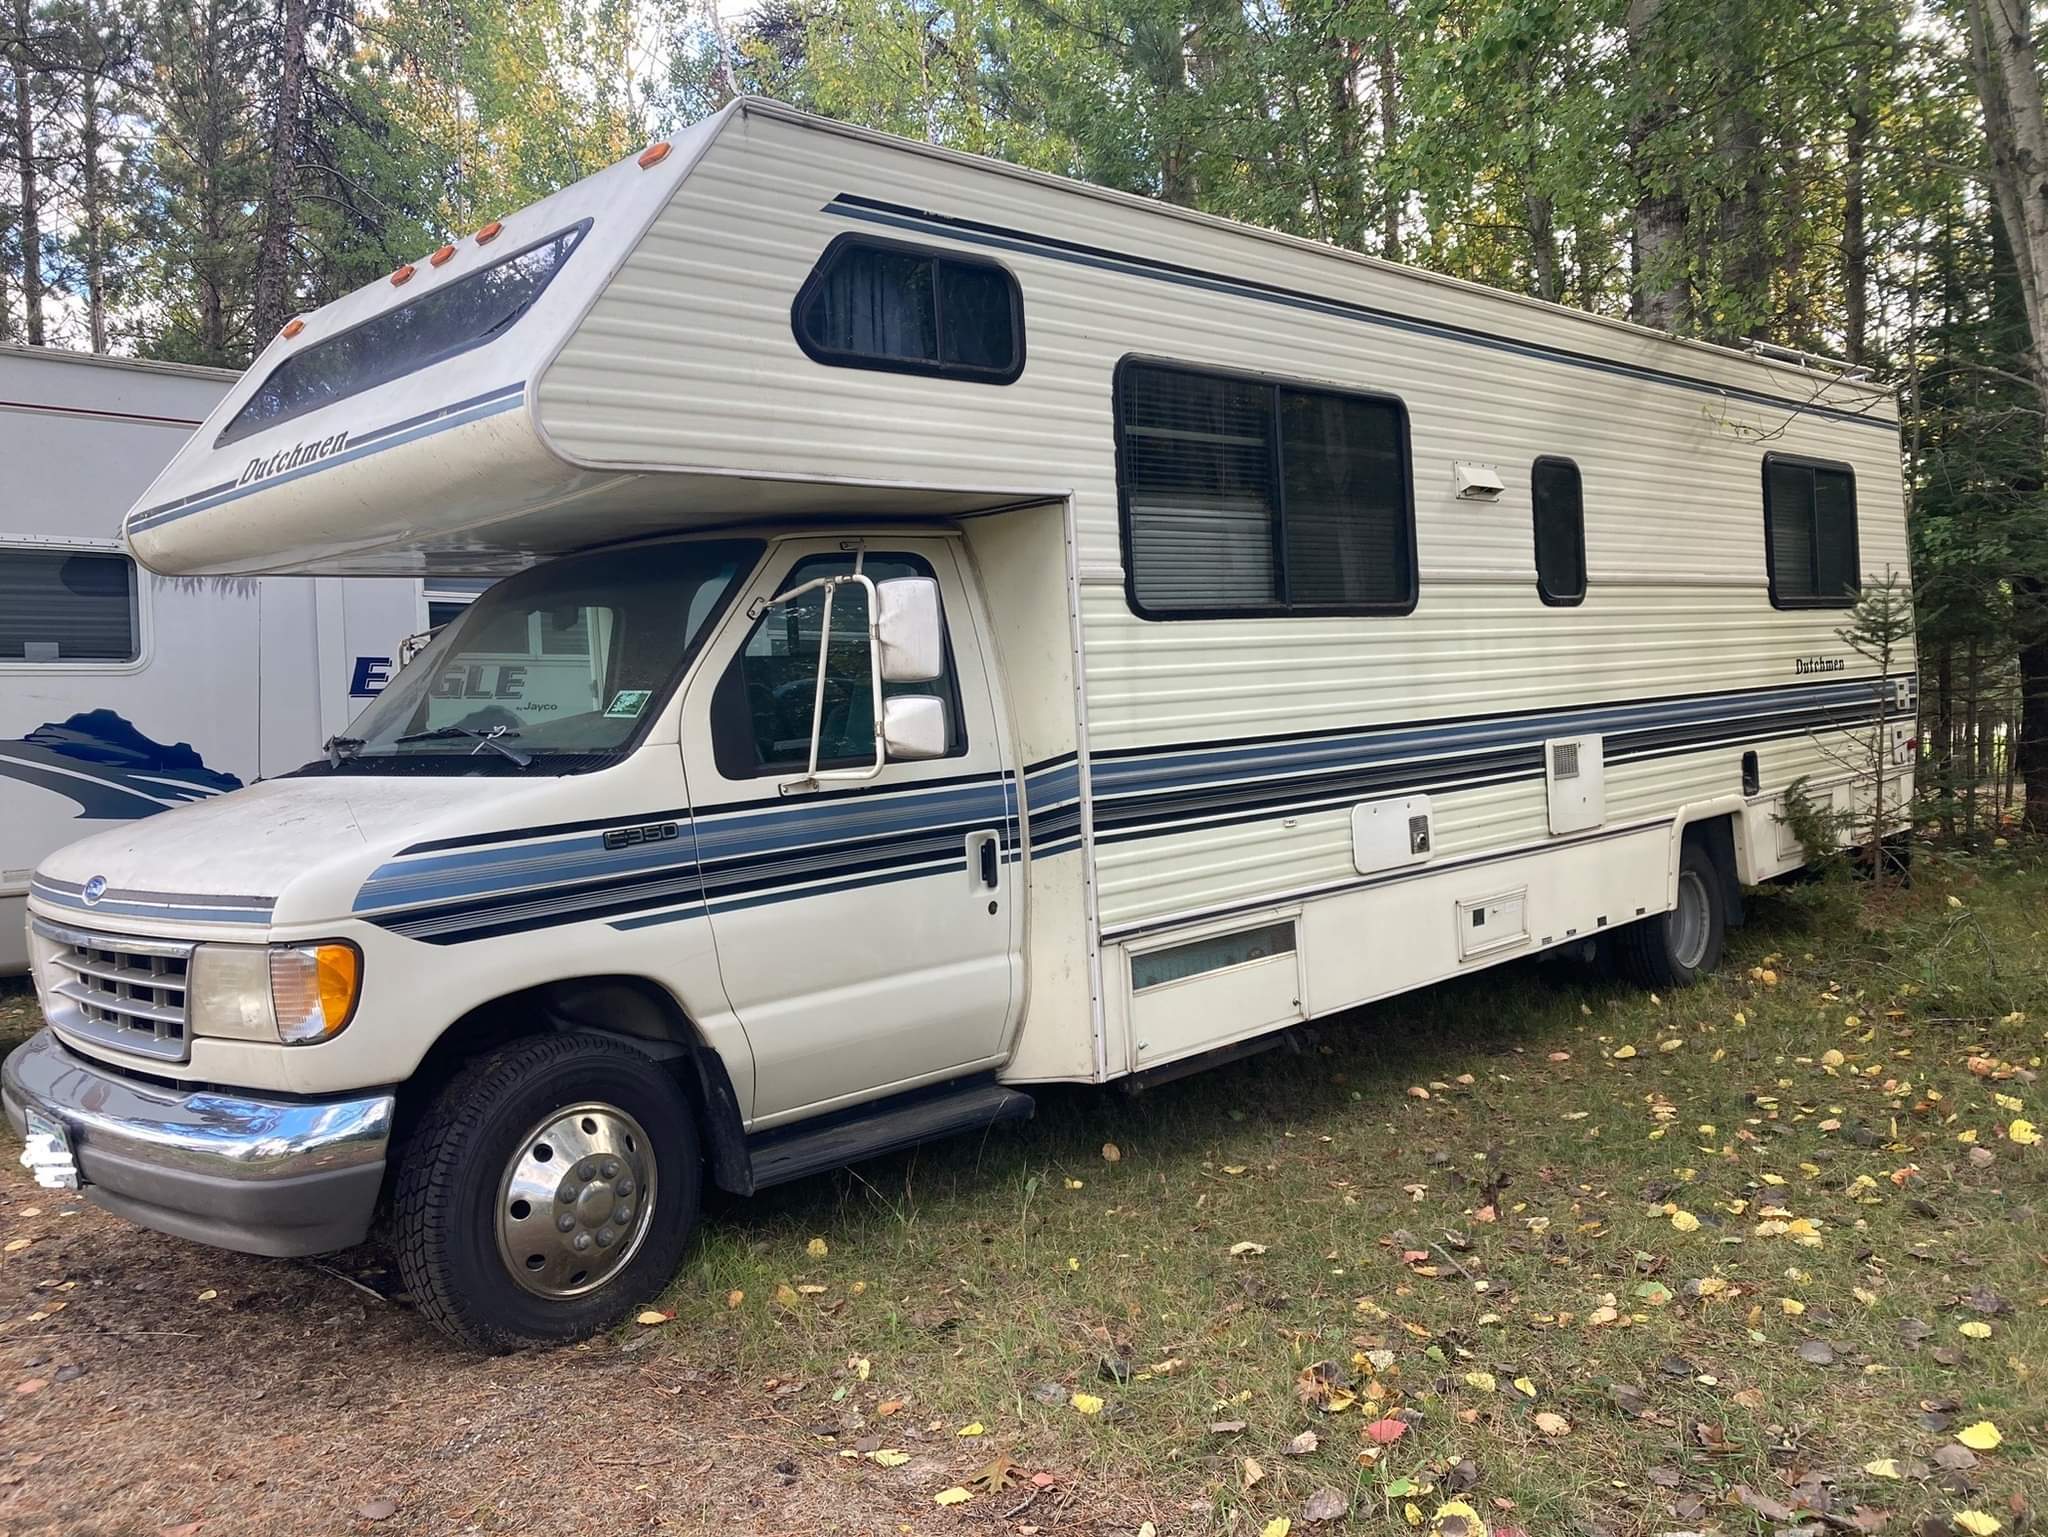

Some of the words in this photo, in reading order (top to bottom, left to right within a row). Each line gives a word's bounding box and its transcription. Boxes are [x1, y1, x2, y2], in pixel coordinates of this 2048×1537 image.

[239, 431, 349, 485] Dutchmen
[349, 656, 528, 700] EGLE
[1795, 656, 1845, 674] Dutchmen
[523, 702, 558, 712] Jayco
[603, 822, 679, 850] E350
